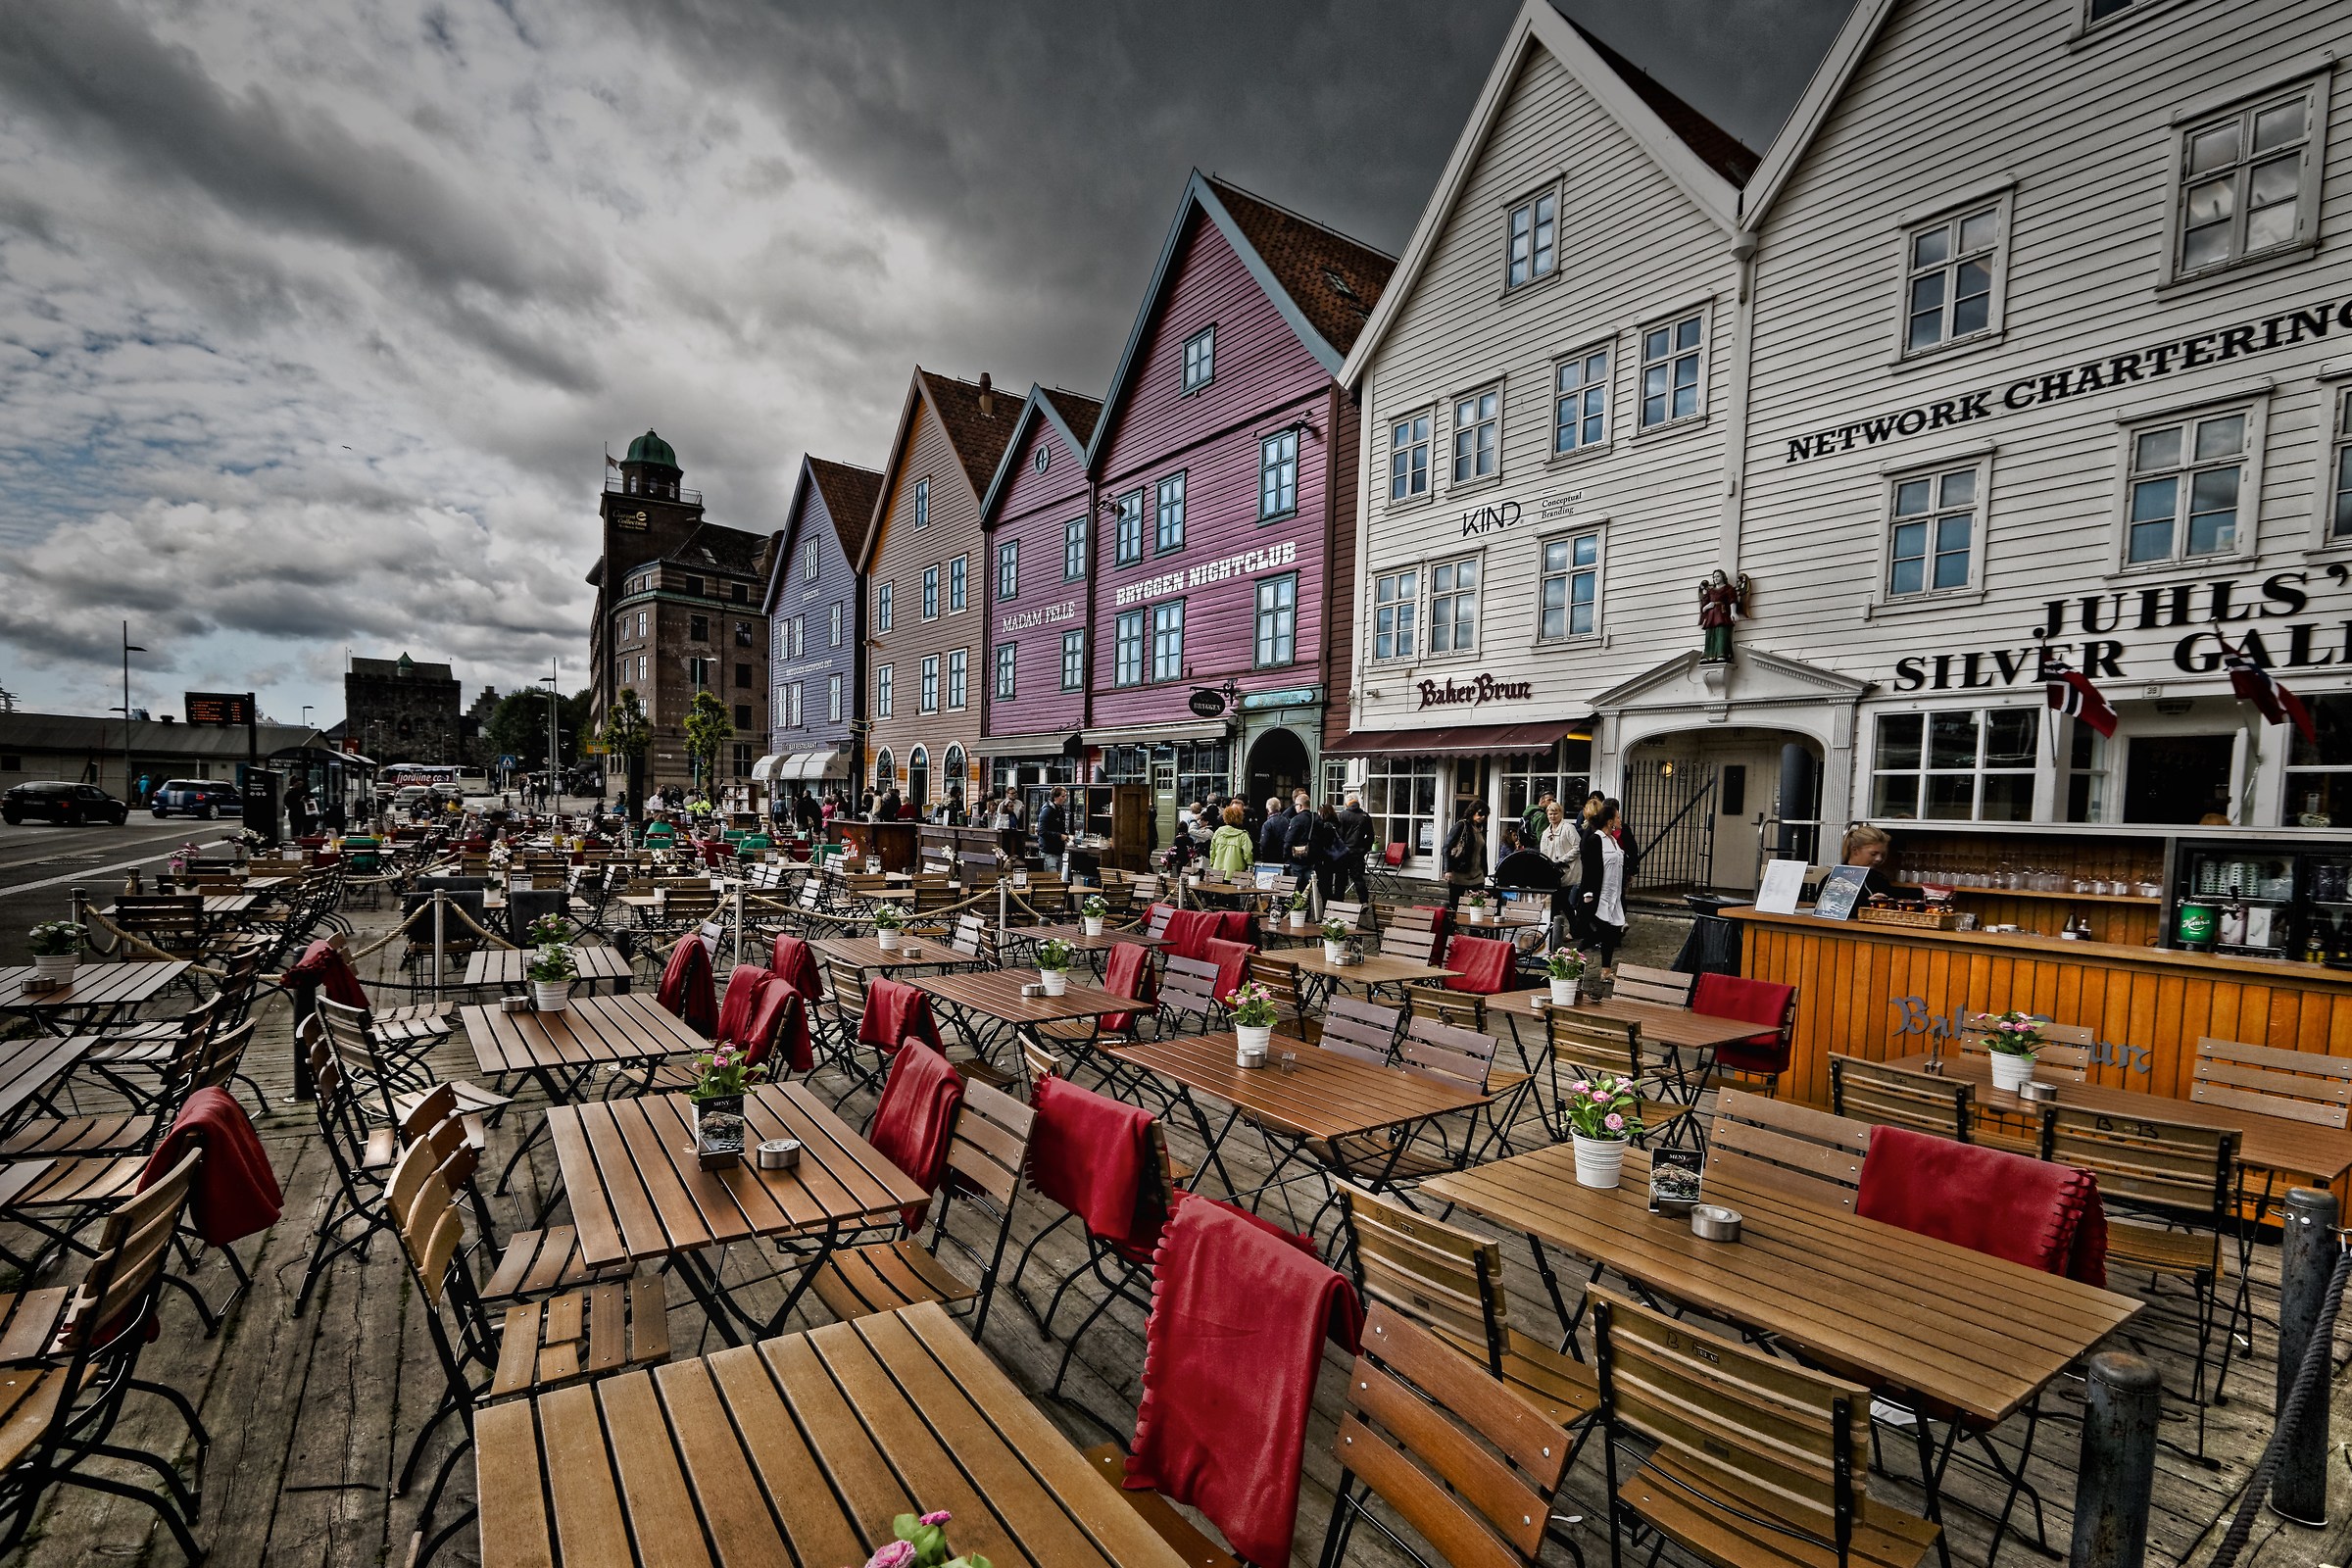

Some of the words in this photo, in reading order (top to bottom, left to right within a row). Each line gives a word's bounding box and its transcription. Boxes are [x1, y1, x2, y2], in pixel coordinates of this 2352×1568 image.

[1787, 390, 1992, 464] NETWORK
[1542, 491, 1583, 508] Conceptual
[1462, 501, 1522, 537] KIND
[1541, 507, 1575, 519] Branding
[1115, 570, 1185, 607] BRYGGEN
[1188, 541, 1297, 588] NIGHTCLUB
[1002, 609, 1043, 633] MADAM
[1045, 601, 1076, 624] FELLE
[1193, 702, 1222, 711] BRYGGEN
[2181, 916, 2211, 931] Hansa
[712, 1099, 731, 1108] MENY
